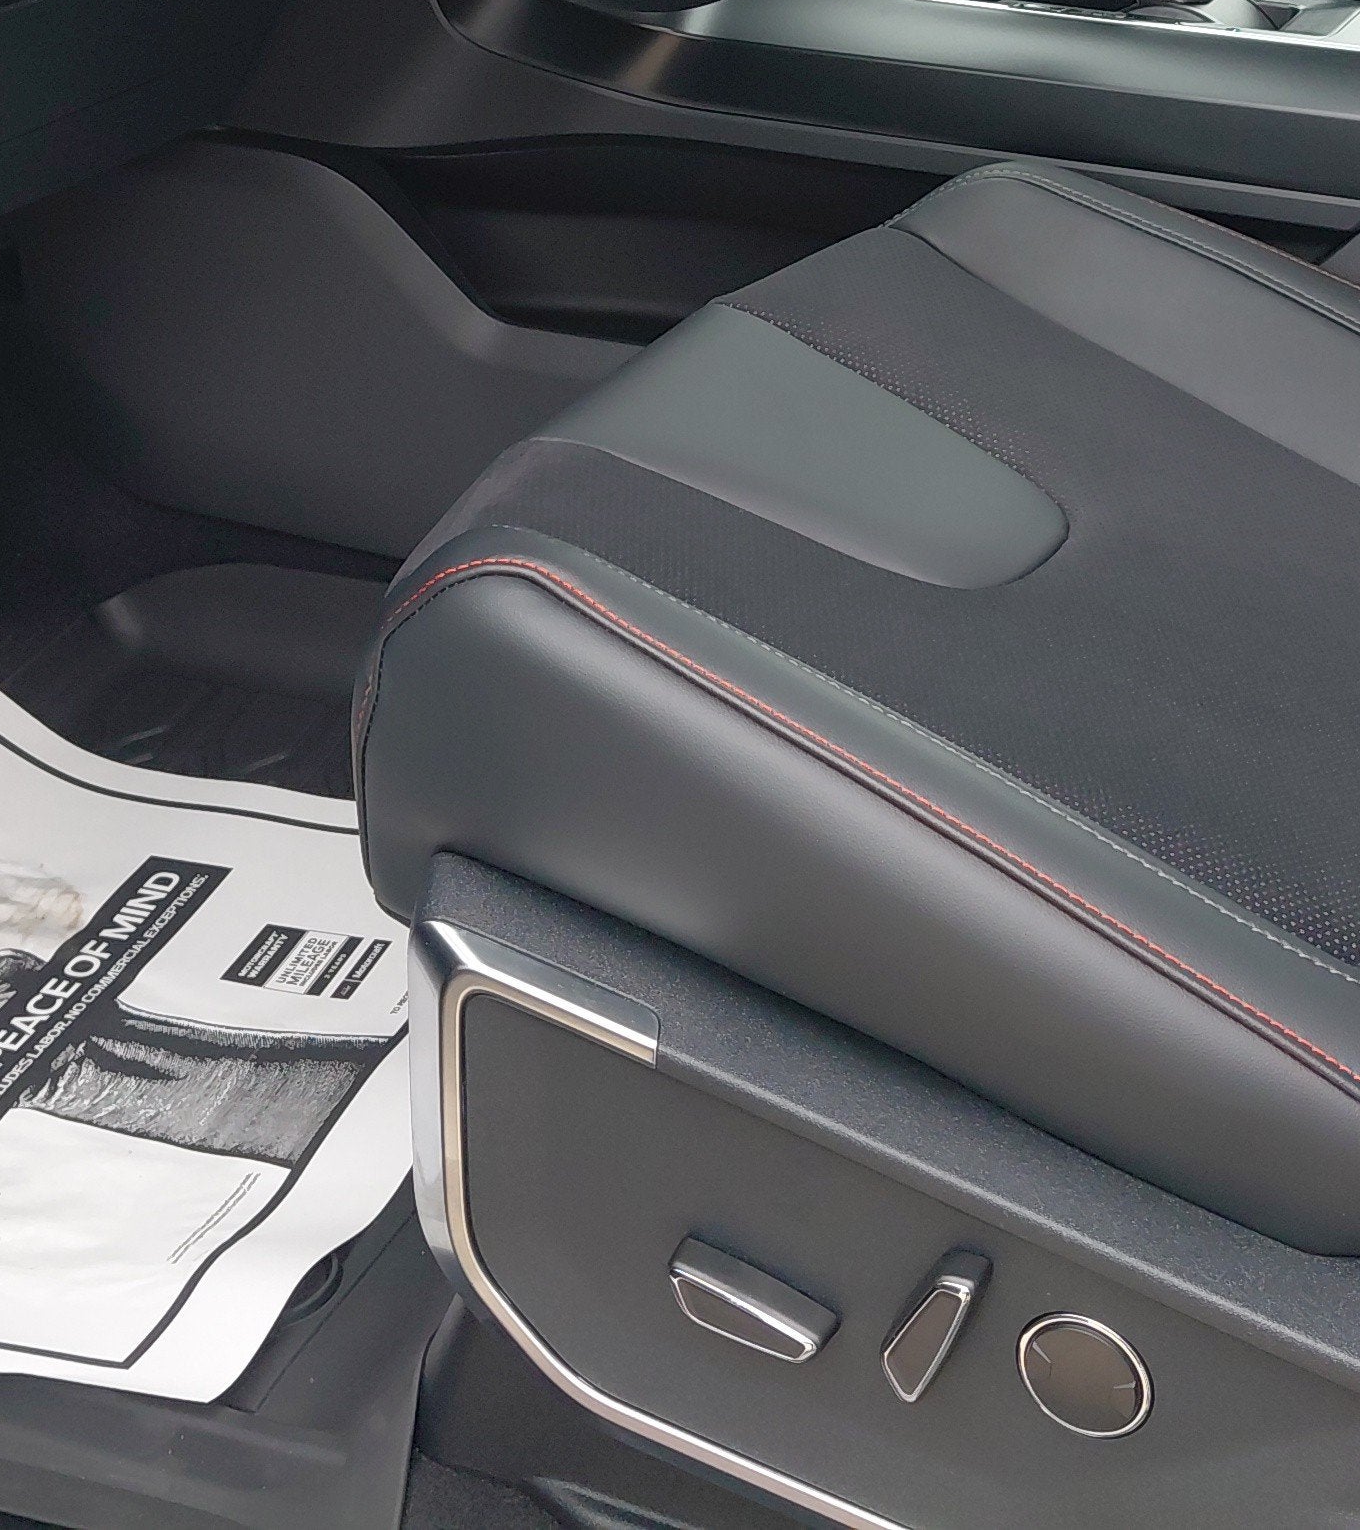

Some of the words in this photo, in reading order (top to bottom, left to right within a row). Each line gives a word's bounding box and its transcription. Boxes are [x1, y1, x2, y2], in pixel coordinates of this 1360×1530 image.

[63, 939, 113, 978] OF
[99, 871, 180, 941] MIND
[67, 1002, 87, 1022] NO
[81, 937, 149, 1004] COMMERCIAL
[247, 933, 289, 979] WARRANTY
[275, 937, 318, 984] UNLIMITED
[286, 939, 331, 986] MILEAGE
[390, 1003, 400, 1015] TO
